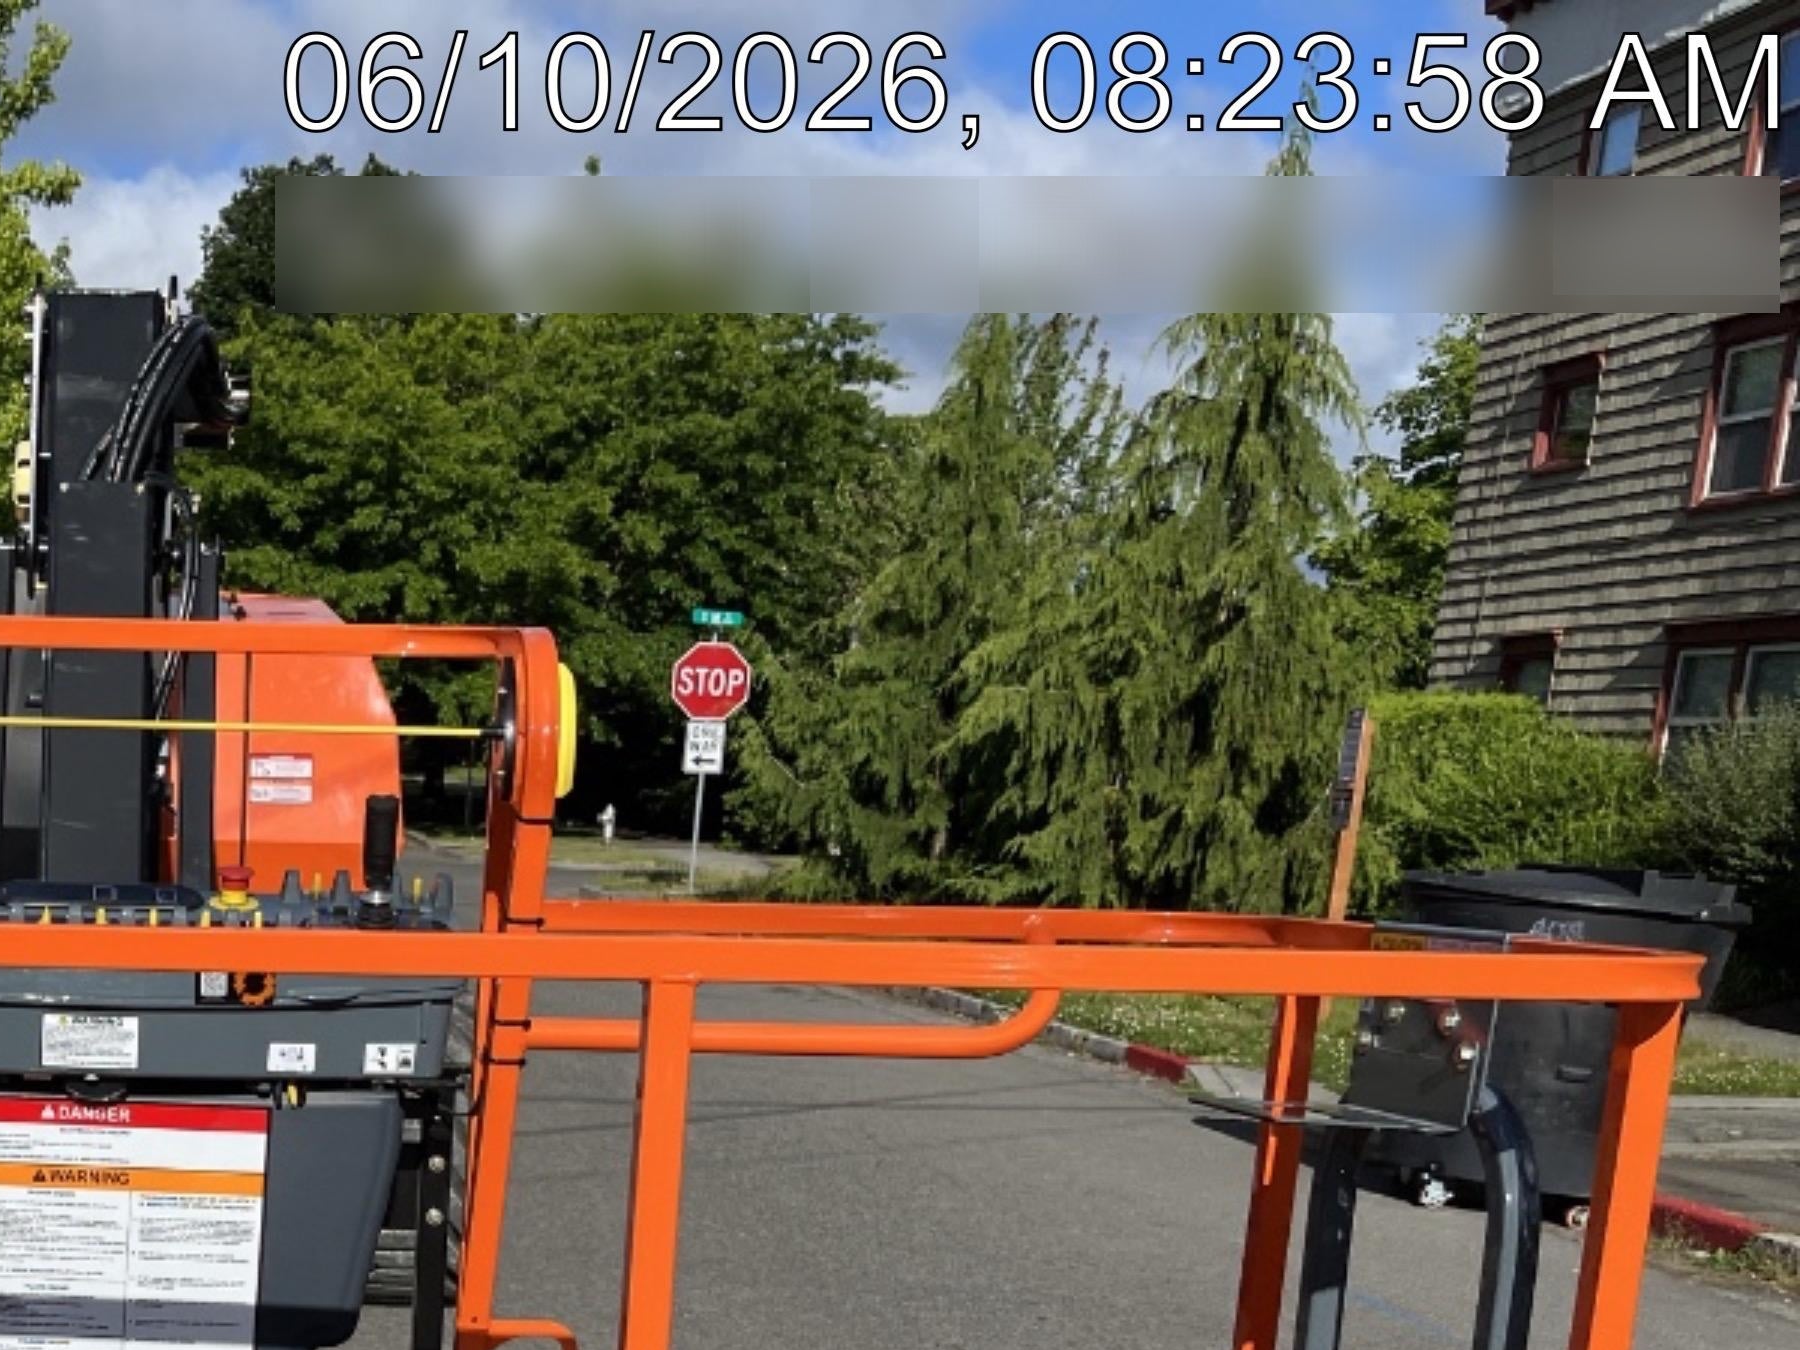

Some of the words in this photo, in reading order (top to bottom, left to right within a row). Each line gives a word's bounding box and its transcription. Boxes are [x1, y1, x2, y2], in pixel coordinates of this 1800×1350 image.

[677, 666, 745, 697] STOP
[59, 1105, 131, 1123] DANGER
[49, 1168, 131, 1185] WARNING
